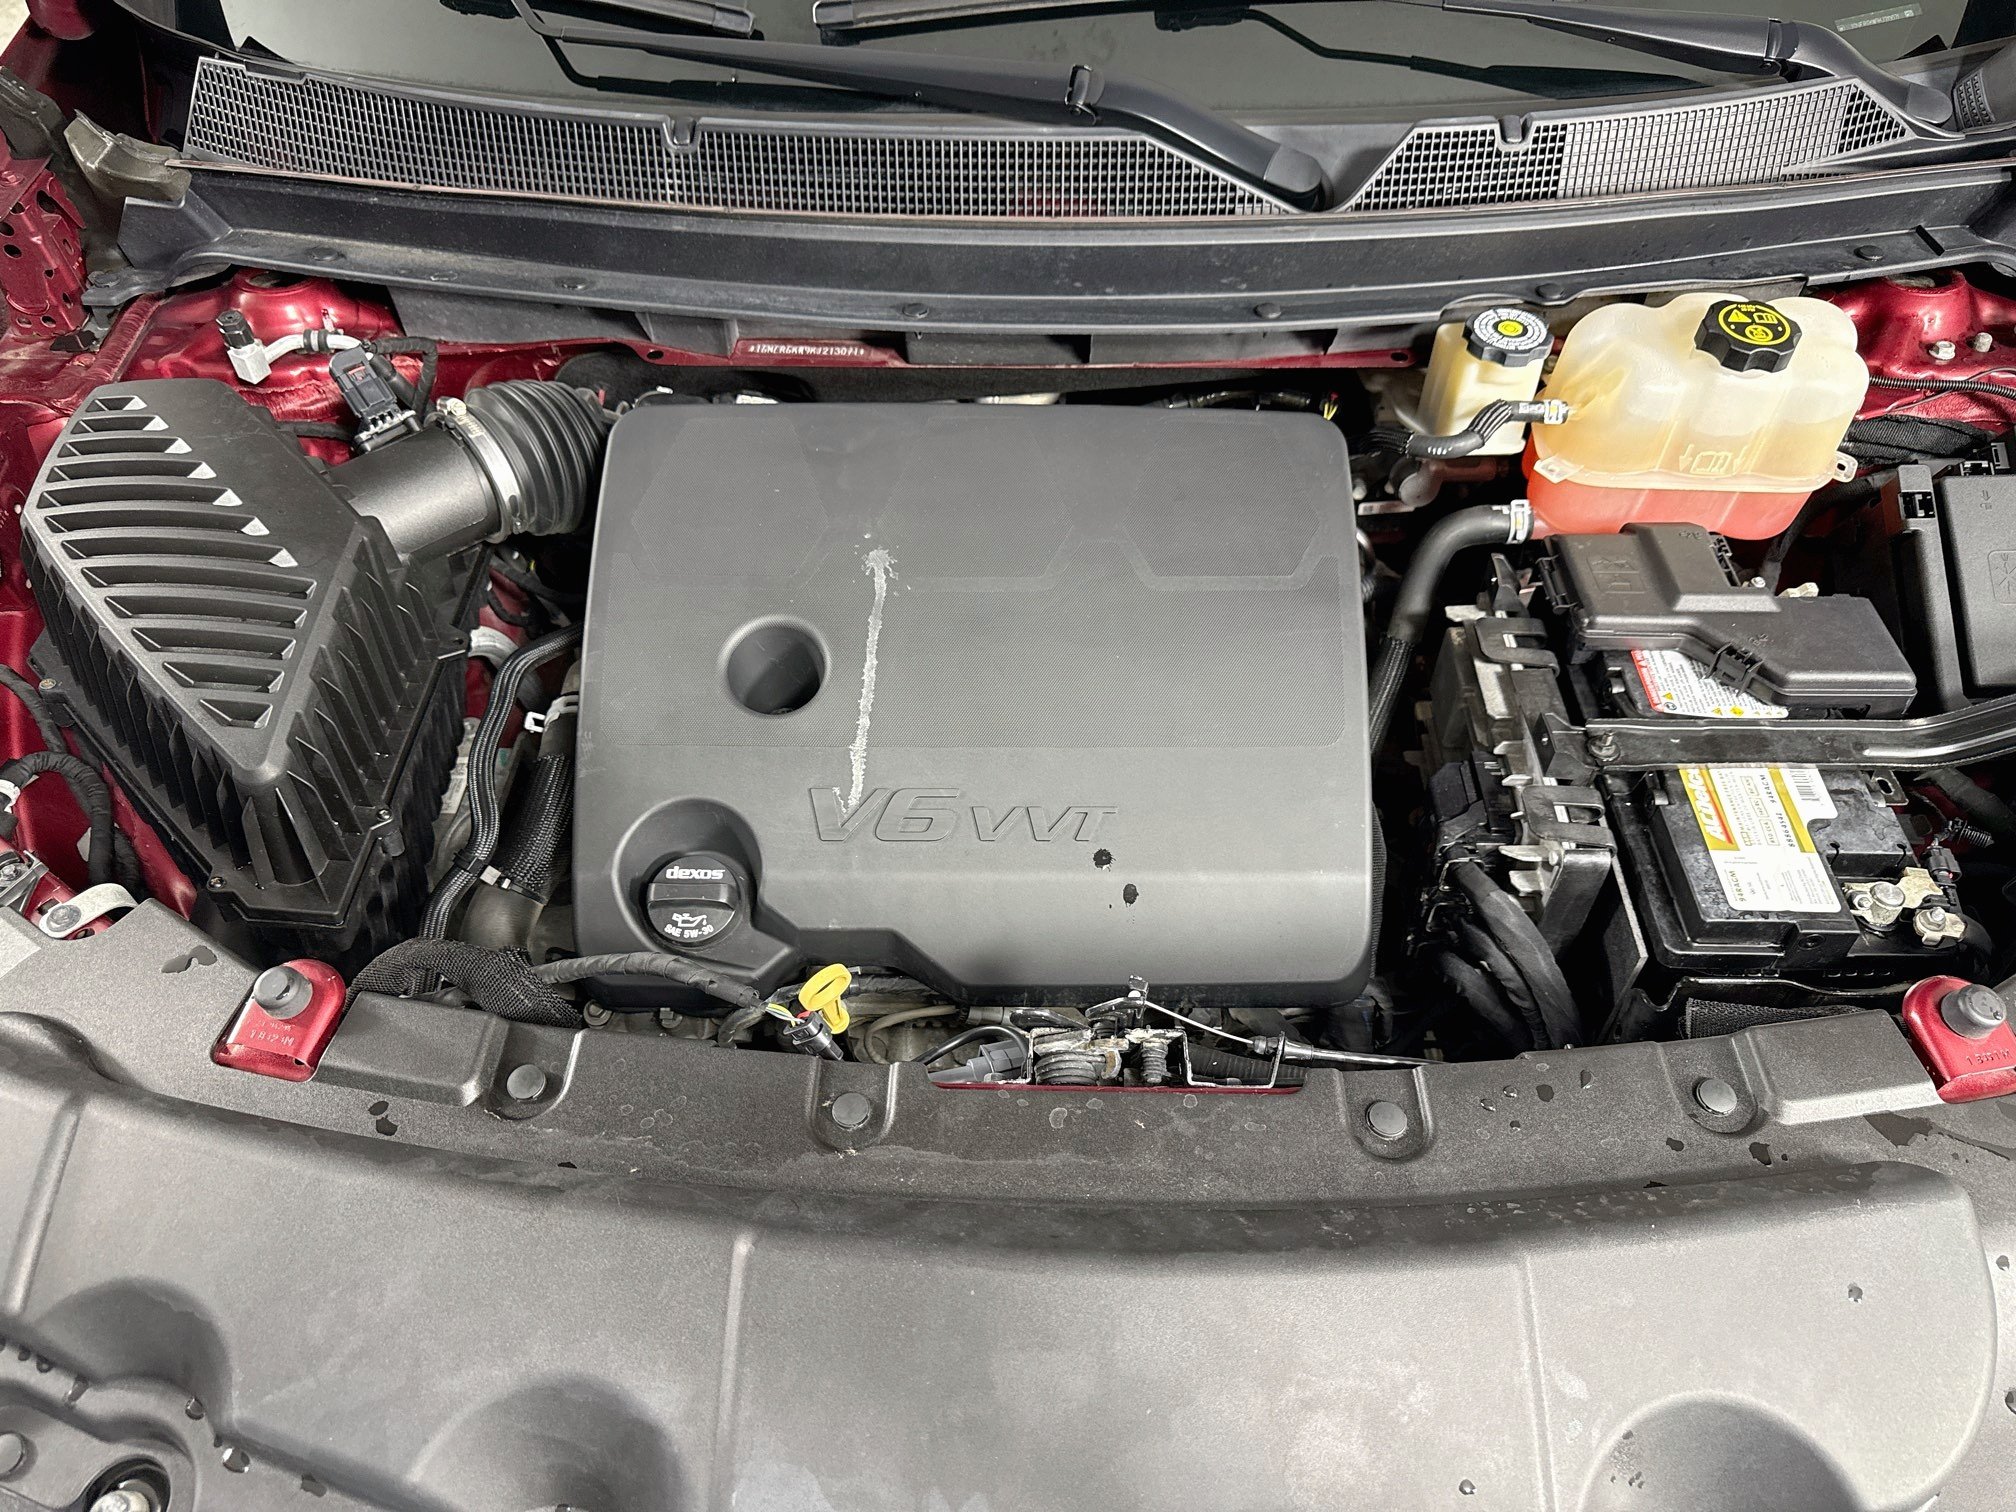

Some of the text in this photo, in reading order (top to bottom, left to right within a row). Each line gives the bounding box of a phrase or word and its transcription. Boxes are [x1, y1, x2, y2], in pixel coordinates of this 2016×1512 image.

[808, 787, 1118, 842] V6 VVT
[665, 865, 726, 880] dexos
[664, 923, 714, 939] SAE 5W-30
